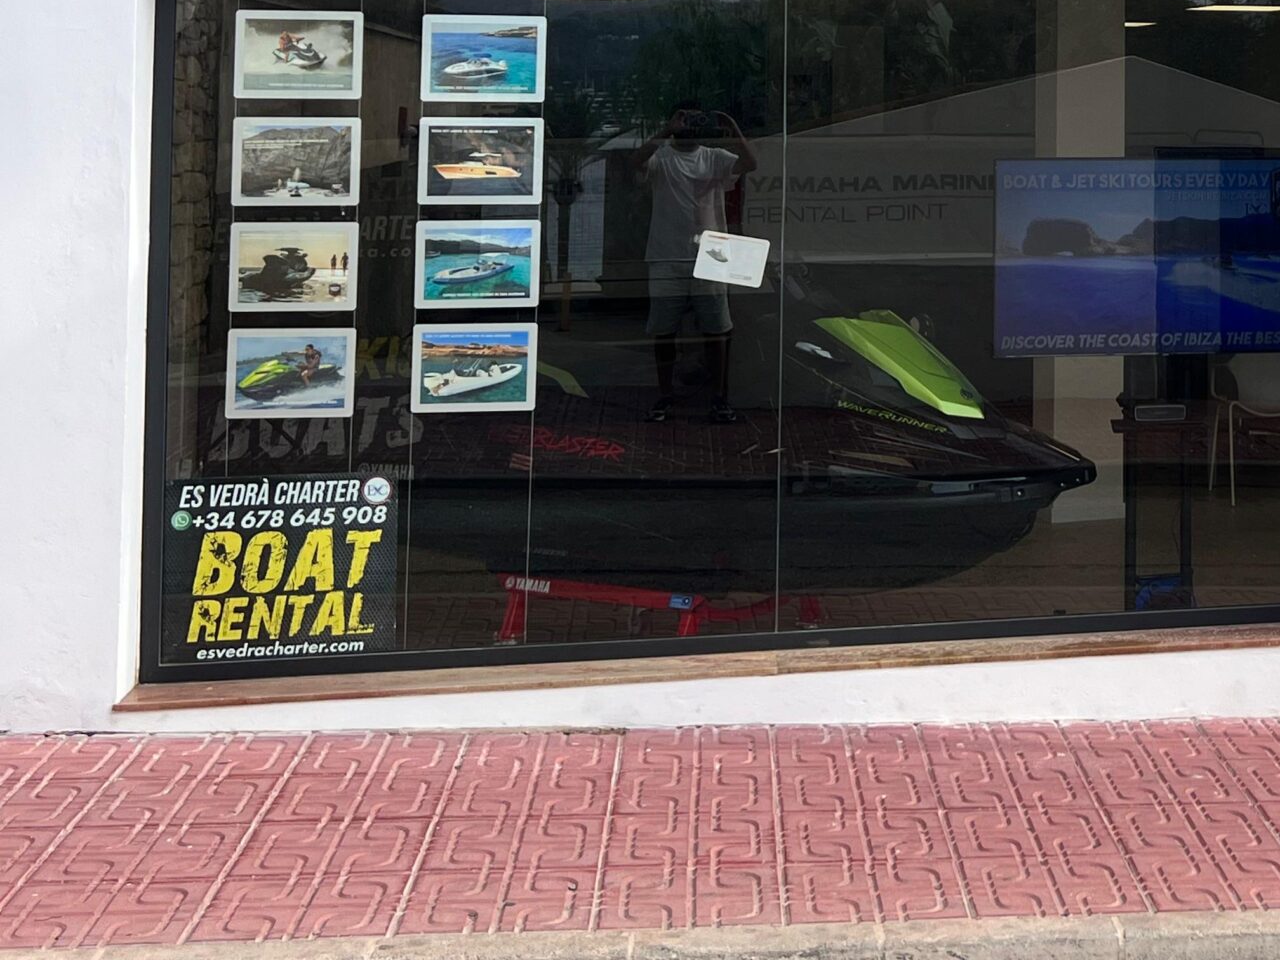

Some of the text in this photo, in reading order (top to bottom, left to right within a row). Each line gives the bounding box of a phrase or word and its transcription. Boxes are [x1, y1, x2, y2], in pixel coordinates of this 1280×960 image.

[749, 175, 882, 193] YAMAHA
[1003, 173, 1050, 190] BOAT
[1052, 174, 1063, 189] &
[1066, 173, 1097, 189] JET
[1099, 173, 1126, 189] SKI
[1127, 173, 1183, 189] TOURS
[747, 202, 950, 224] RENTAL POINT
[1001, 334, 1075, 351] DISCOVER
[1078, 334, 1106, 349] THE
[1108, 332, 1160, 349] COAST
[1160, 333, 1182, 348] OF
[1184, 332, 1222, 347] IBIZA
[1227, 332, 1252, 346] THE
[836, 399, 949, 434] WAVERUNNER
[179, 477, 361, 509] ES VEDRÀ CHARTER
[192, 505, 388, 531] +34 678 645 908
[192, 527, 383, 596] BOAT
[515, 576, 552, 594] YAMAHA
[186, 591, 375, 644] RENTAL
[196, 640, 365, 660] esvedracharter.com
